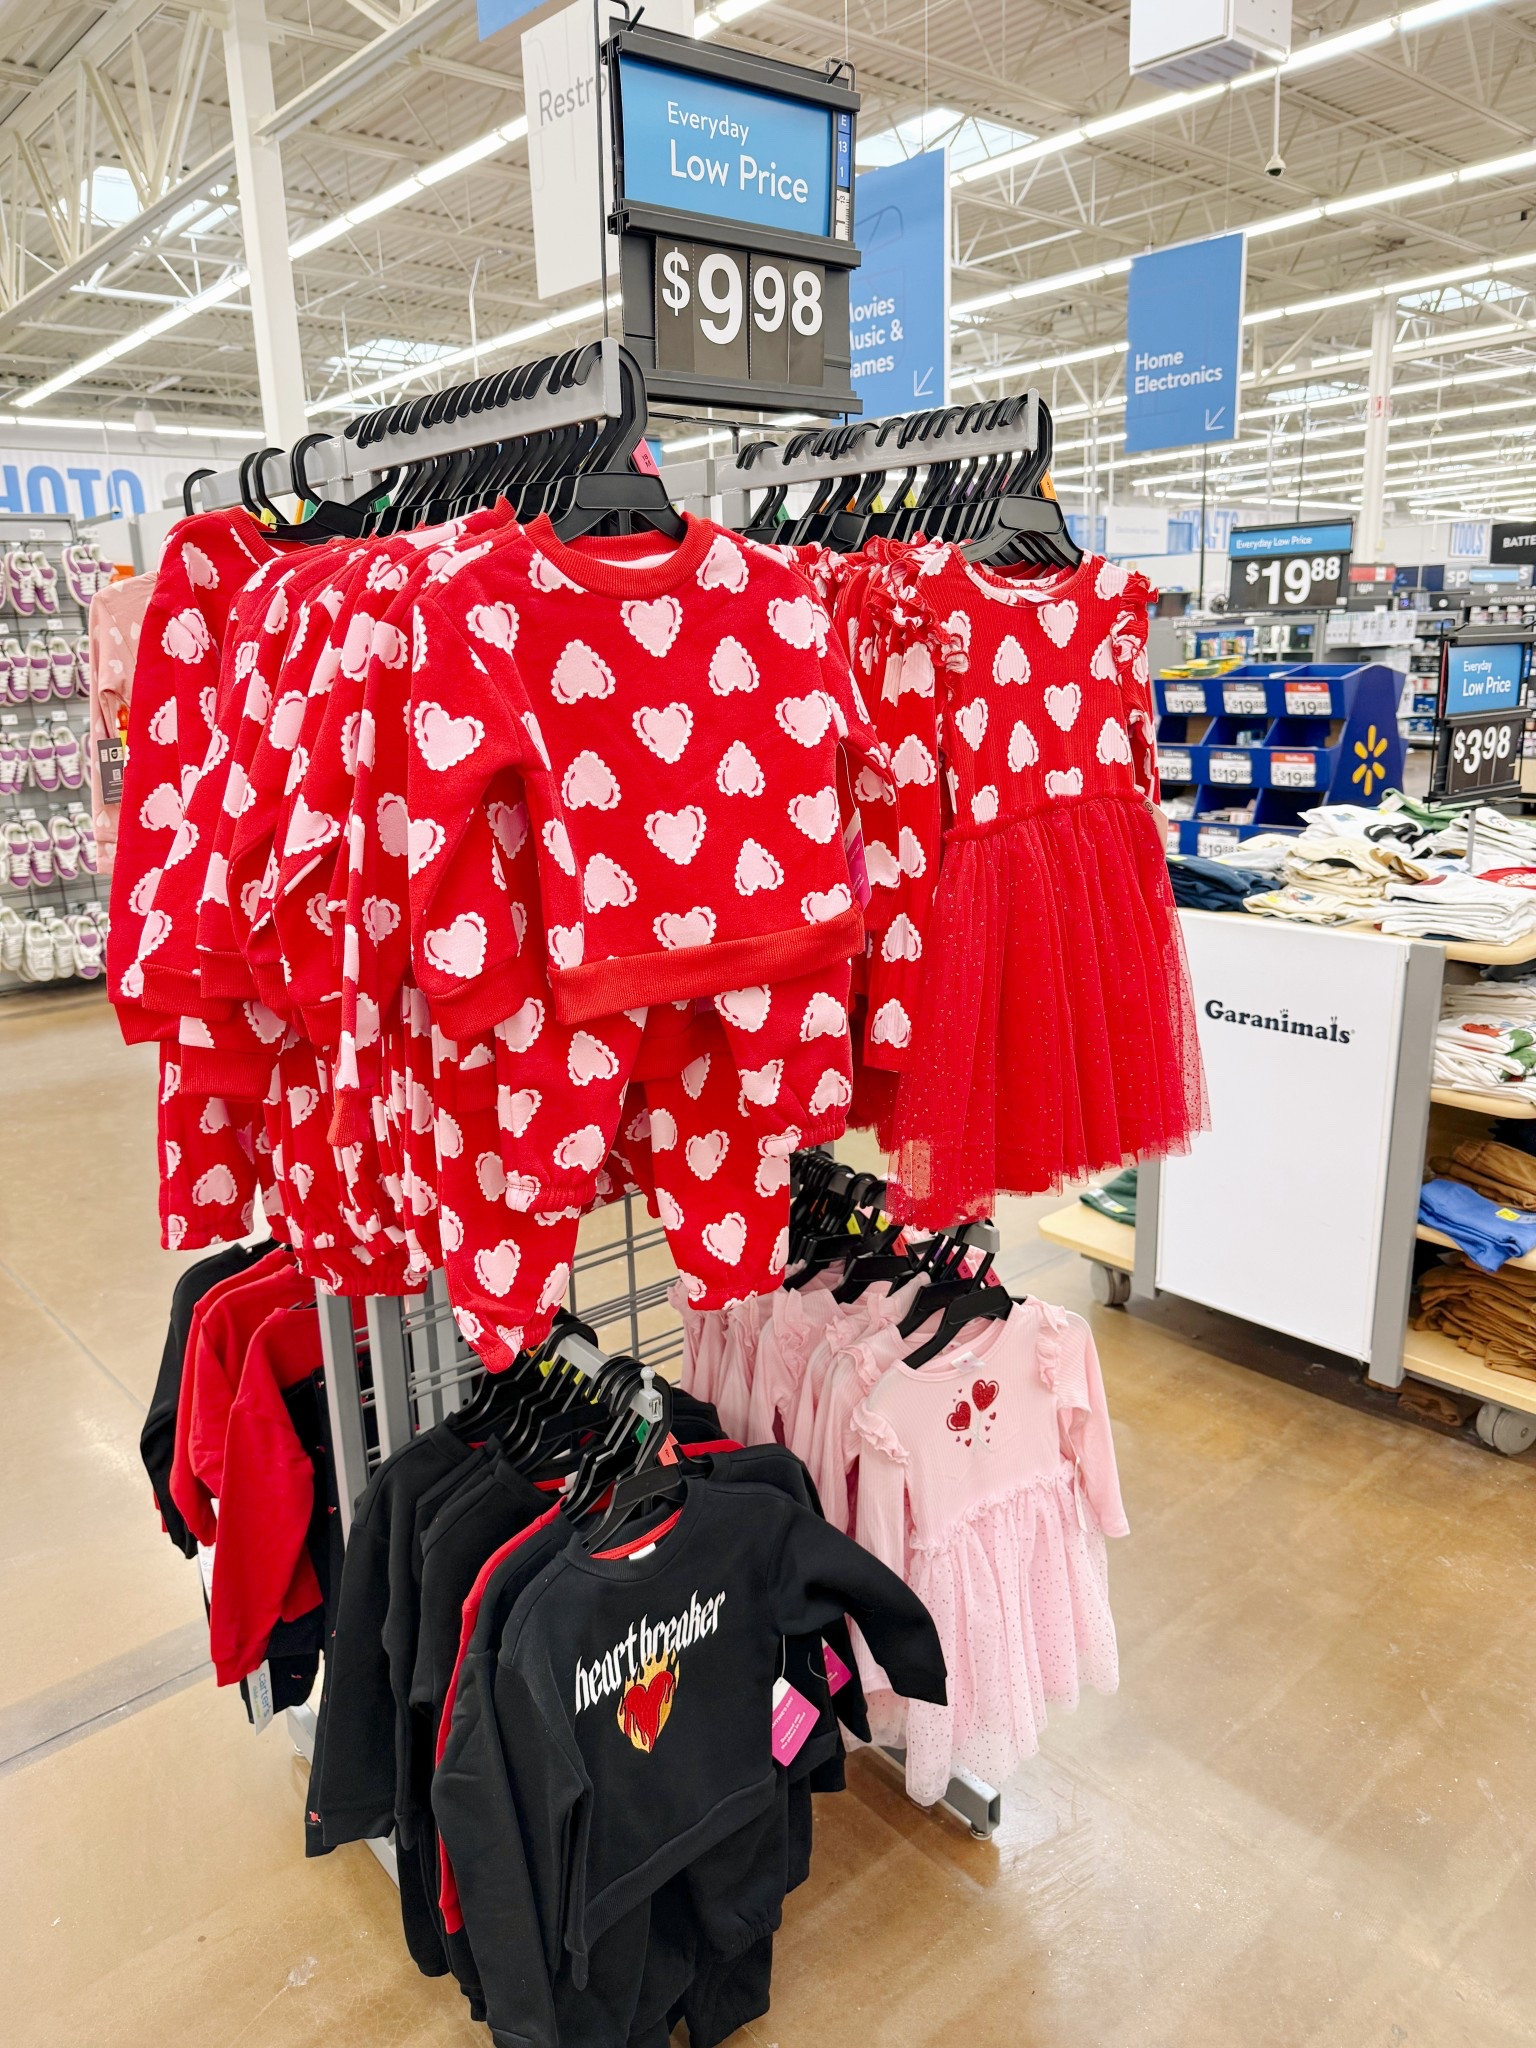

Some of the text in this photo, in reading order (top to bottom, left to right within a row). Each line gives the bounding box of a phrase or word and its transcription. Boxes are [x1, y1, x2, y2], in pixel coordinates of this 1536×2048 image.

[667, 101, 749, 146] Everyday
[841, 115, 848, 127] E
[838, 141, 848, 153] 13
[670, 139, 809, 204] Low Price
[890, 319, 904, 342] &
[850, 355, 895, 378] ames
[1135, 351, 1184, 372] Home
[1135, 365, 1223, 394] Electronics
[1236, 536, 1312, 550] Everyday Low Price
[1464, 660, 1492, 674] Everyday
[1463, 676, 1511, 696] Low Price
[1205, 1000, 1350, 1044] Garanimals
[258, 1673, 270, 1717] carter's
